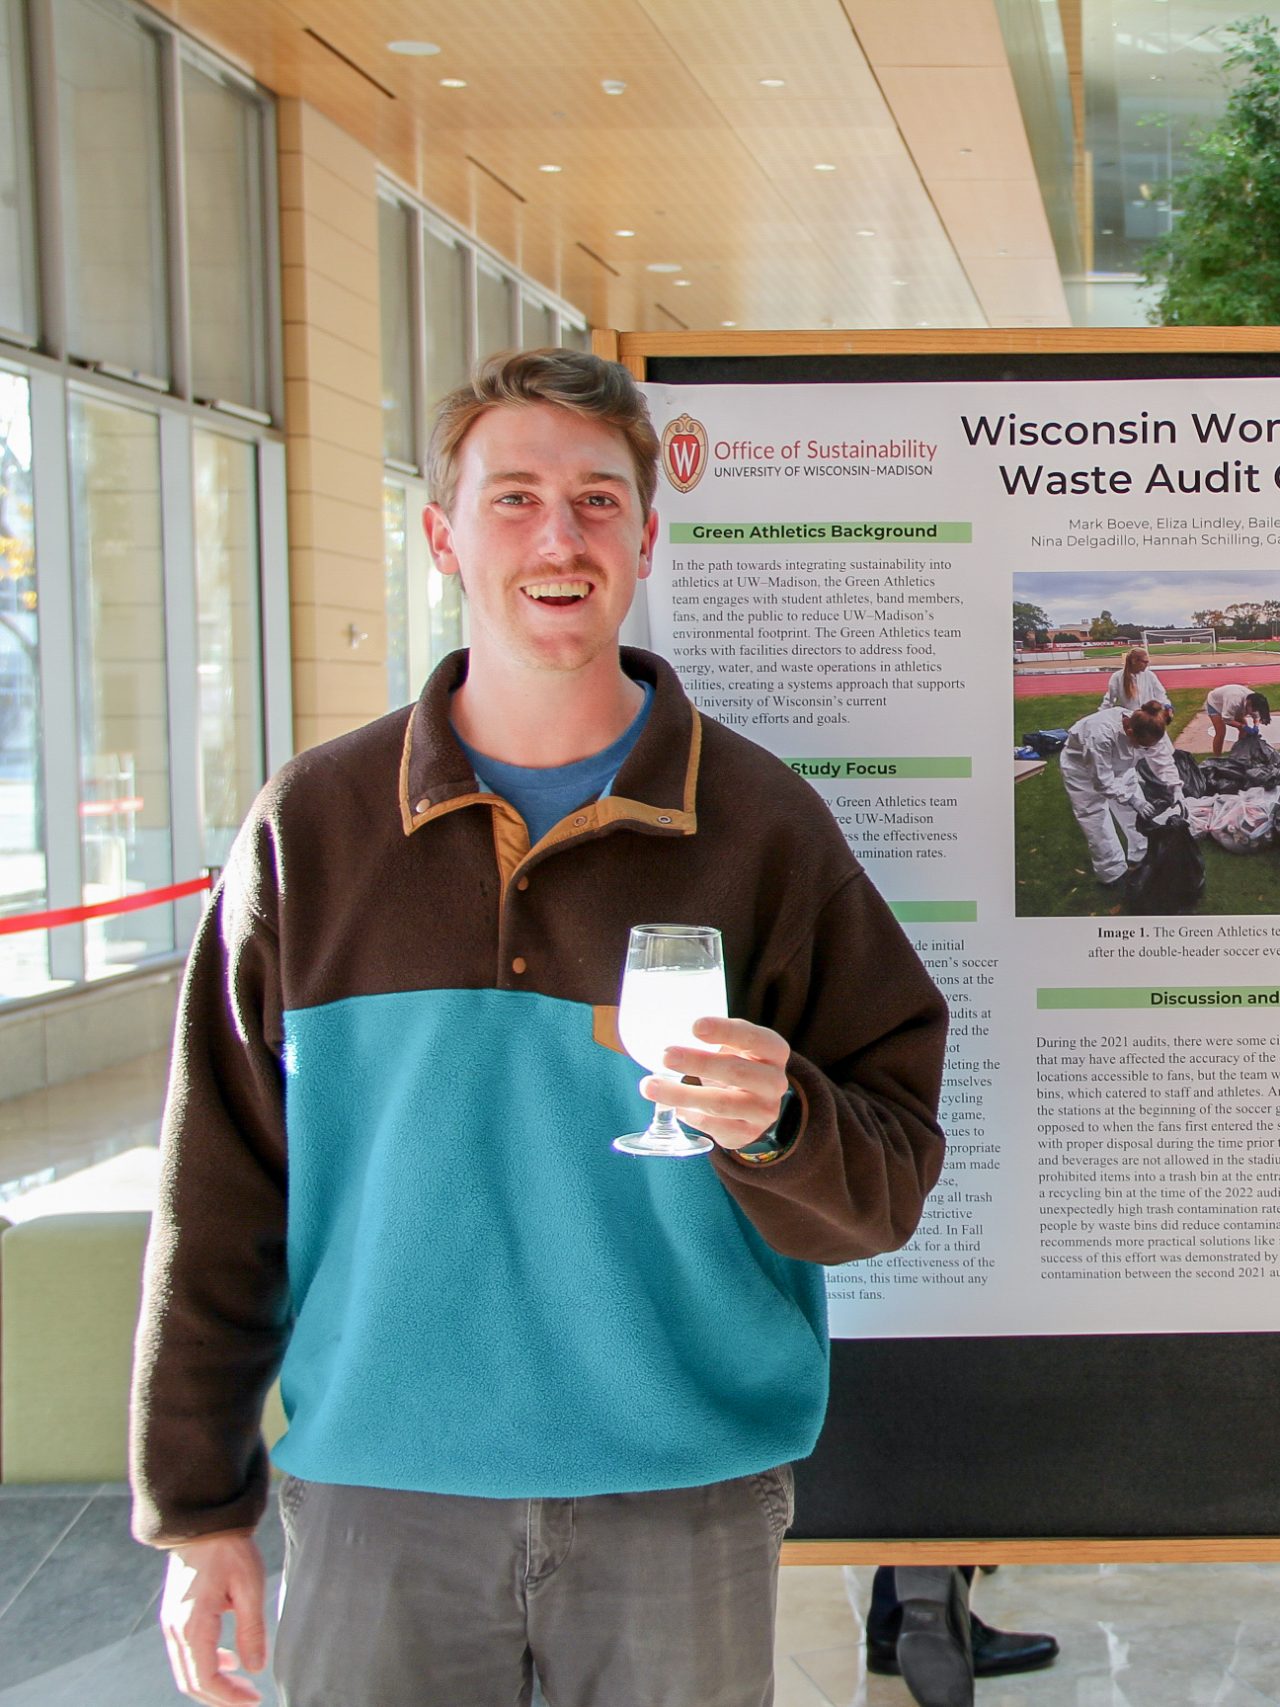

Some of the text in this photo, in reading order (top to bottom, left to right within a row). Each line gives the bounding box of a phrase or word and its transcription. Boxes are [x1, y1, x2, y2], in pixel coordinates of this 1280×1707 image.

[960, 410, 1176, 446] Wisconsin
[714, 439, 937, 462] Office of Sustainability
[714, 466, 781, 477] UNIVERSITY
[784, 465, 800, 476] OF
[998, 464, 1132, 495] Waste
[1144, 459, 1260, 493] Audit
[692, 523, 937, 541] Green Athletics Background
[1069, 518, 1103, 530] Mark
[1107, 518, 1152, 531] Boeve,
[1156, 517, 1187, 529] Eliza
[1192, 517, 1244, 531] Lindley,
[1031, 535, 1062, 547] Nina
[1066, 533, 1138, 549] Delgadillo,
[1142, 533, 1197, 546] Hannah
[1201, 532, 1263, 548] Schilling,
[672, 557, 951, 574] In the path towards integrating sustainability into
[790, 761, 896, 778] Study Focus
[1097, 926, 1135, 941] Image
[1139, 927, 1149, 937] 1.
[1153, 926, 1175, 937] The
[1178, 926, 1213, 937] Green
[1217, 925, 1267, 937] Athletics
[1088, 946, 1115, 958] after
[1117, 945, 1135, 957] the
[1138, 945, 1220, 957] double-header
[1223, 947, 1260, 956] soccer
[1151, 990, 1242, 1005] Discussion
[1247, 990, 1279, 1004] and
[1040, 1267, 1121, 1279] contamination
[1124, 1267, 1171, 1279] between
[1174, 1267, 1192, 1278] the
[1195, 1266, 1234, 1278] second
[1238, 1266, 1264, 1278] 2021
[858, 1288, 885, 1299] fans.
